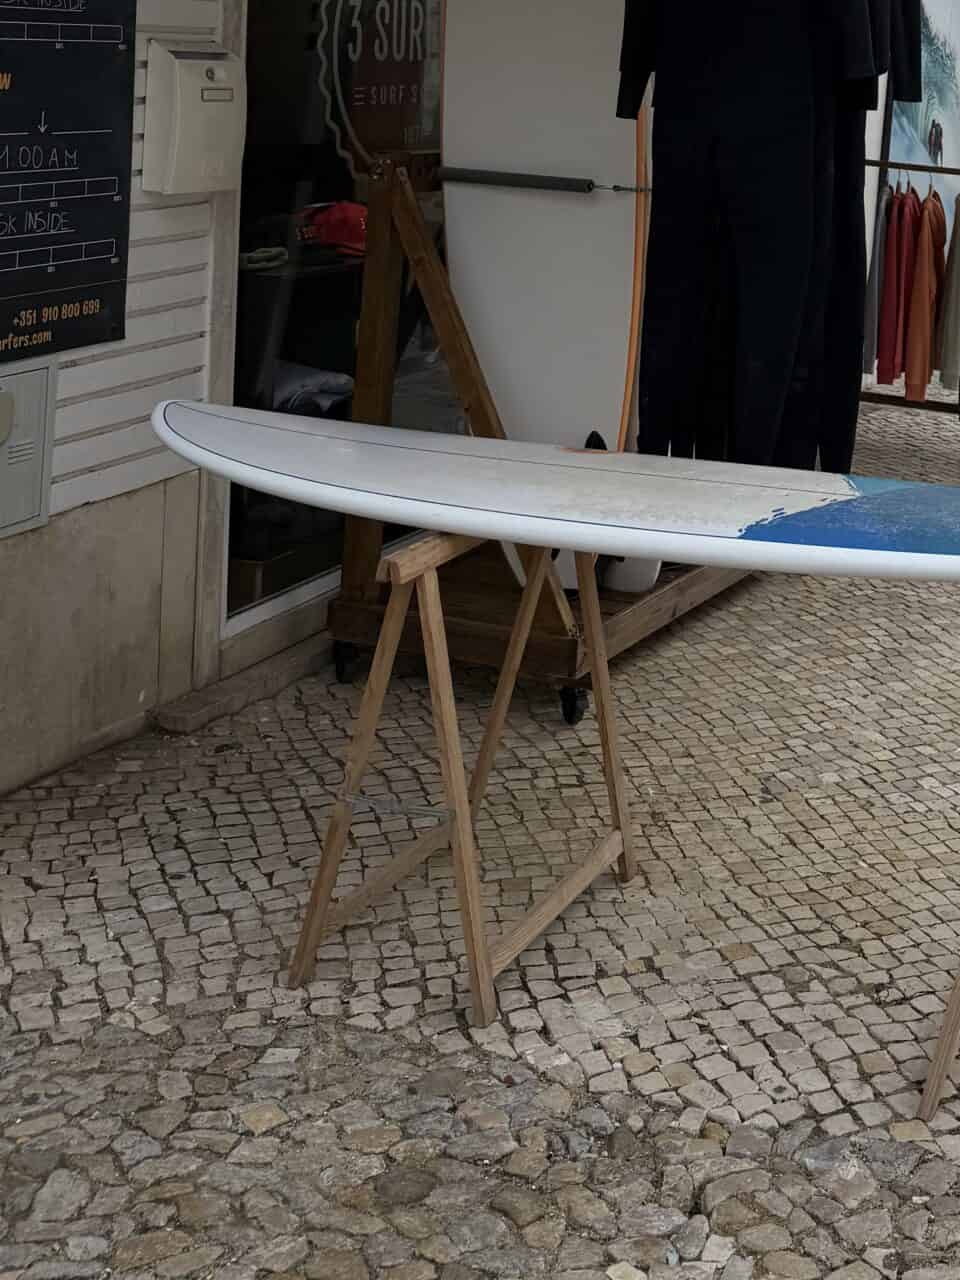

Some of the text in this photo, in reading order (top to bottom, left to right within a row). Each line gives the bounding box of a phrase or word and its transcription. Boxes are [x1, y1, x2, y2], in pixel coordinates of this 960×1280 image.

[24, 208, 67, 233] INSIDE
[12, 309, 37, 327] +351
[41, 305, 59, 323] 910
[61, 302, 81, 320] 800
